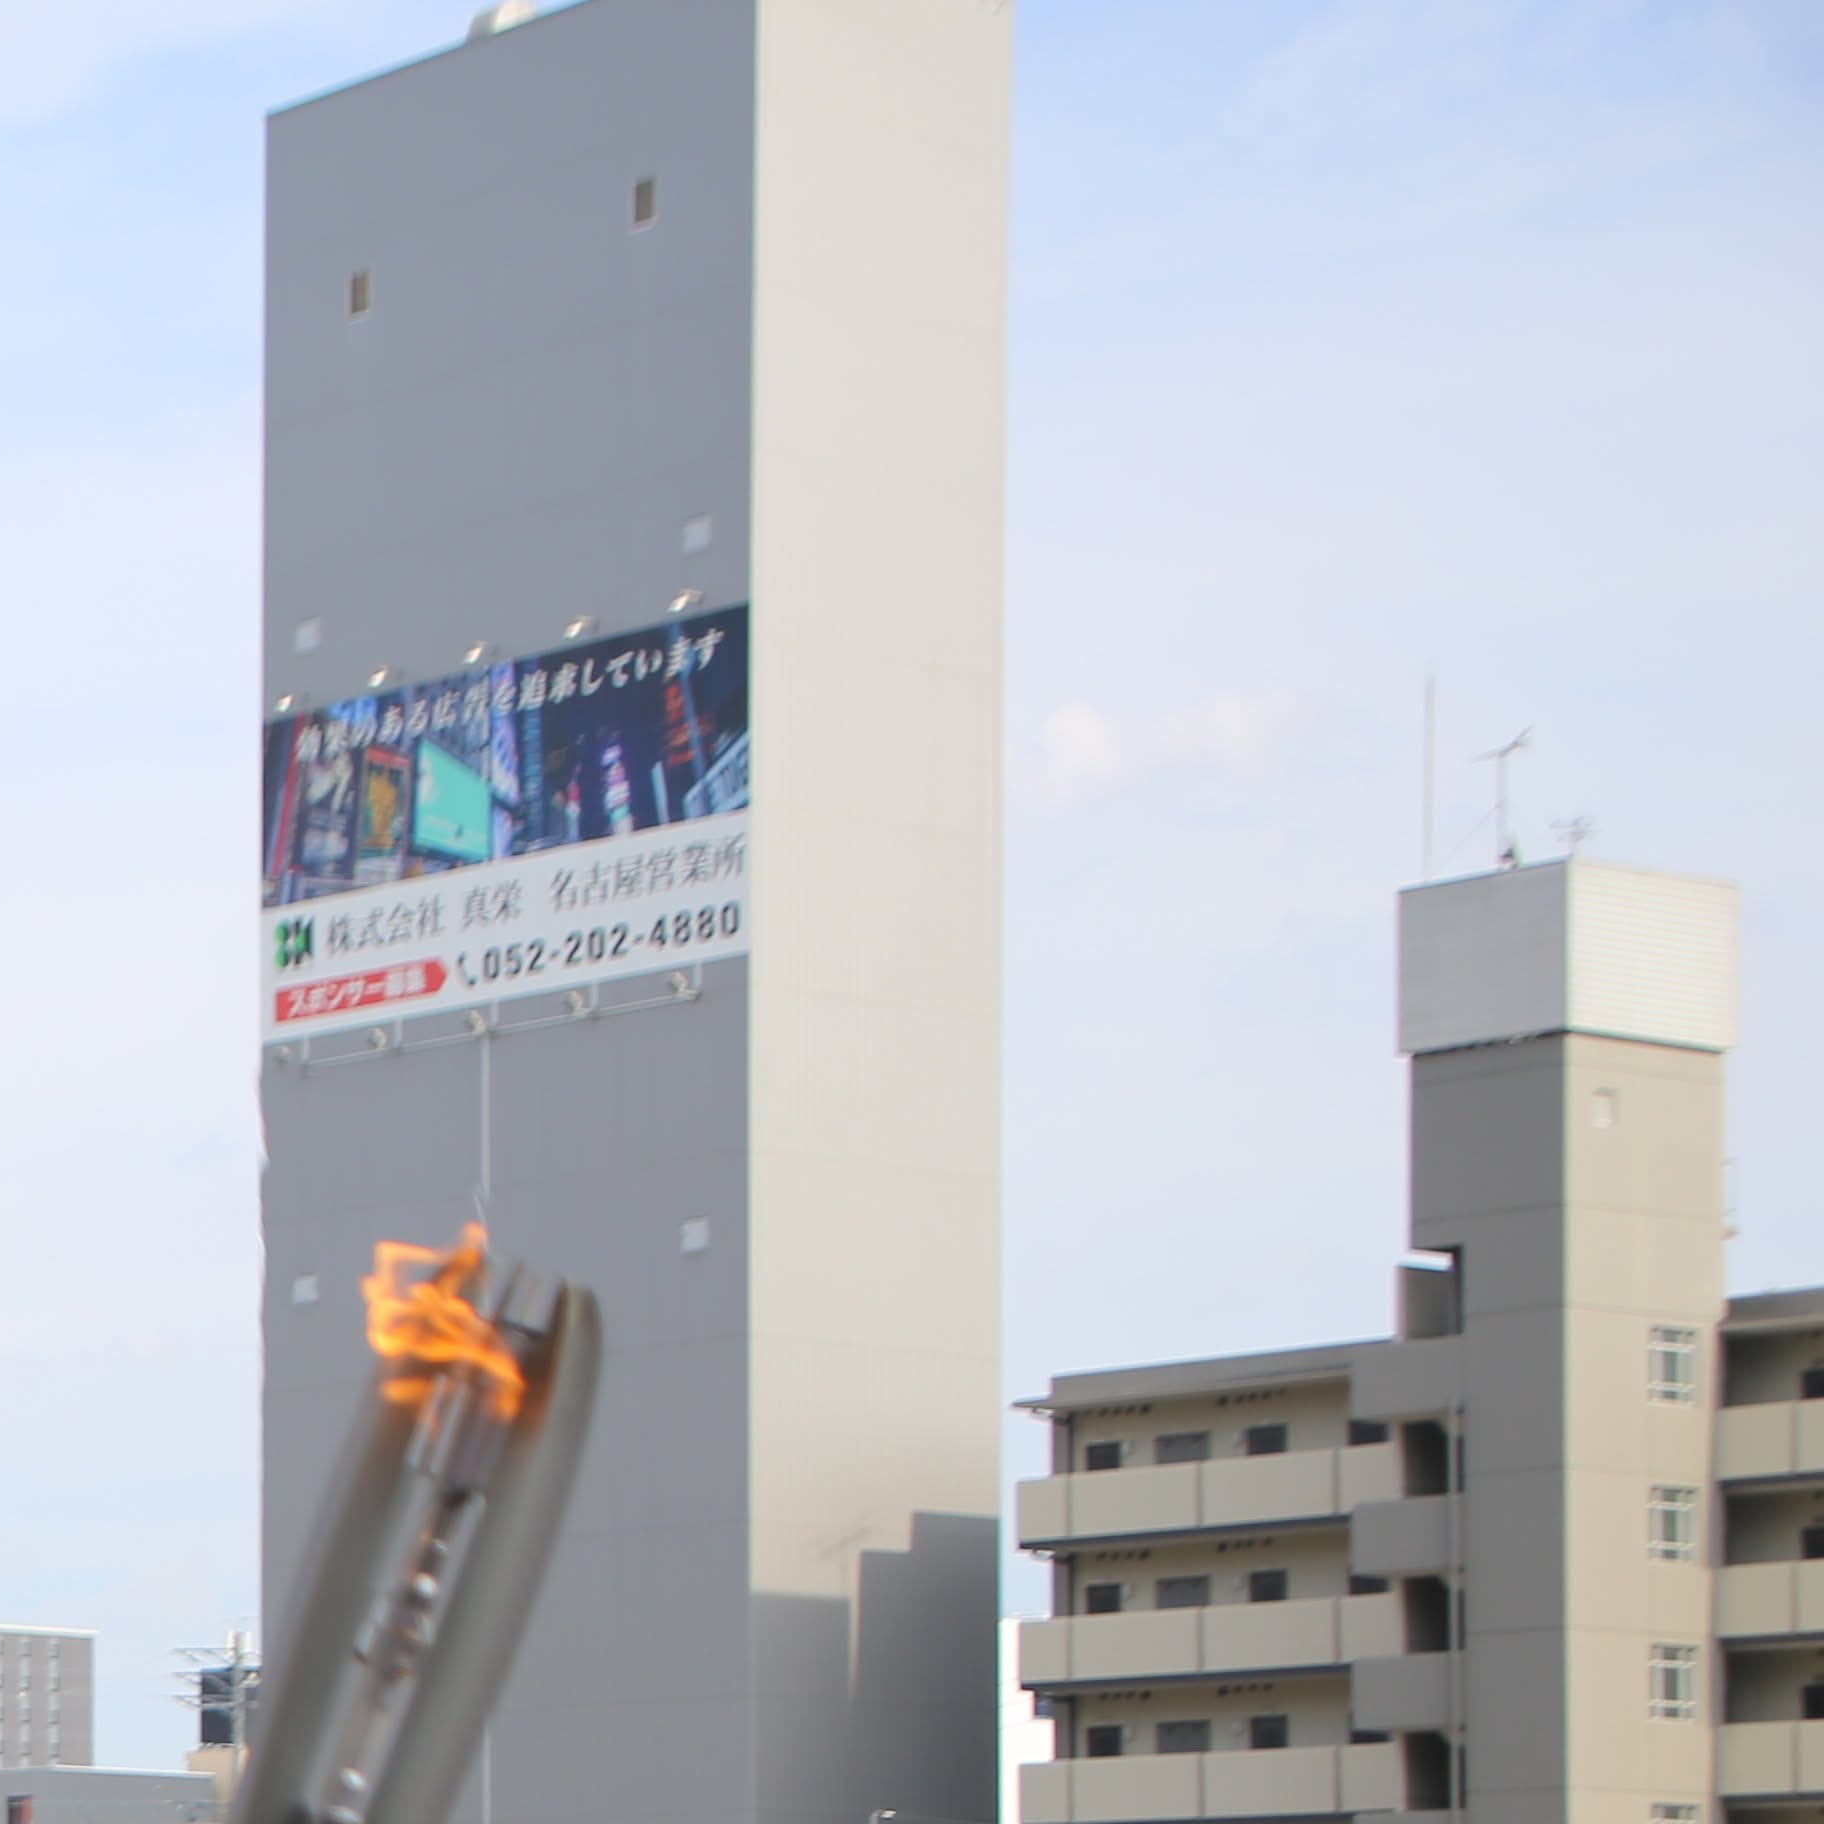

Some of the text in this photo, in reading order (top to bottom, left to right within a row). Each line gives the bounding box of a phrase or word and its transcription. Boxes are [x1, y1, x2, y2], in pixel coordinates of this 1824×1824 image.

[326, 893, 446, 956] 株式会社
[549, 832, 748, 913] 名古屋営業所
[483, 899, 740, 981] 052-202-4880
